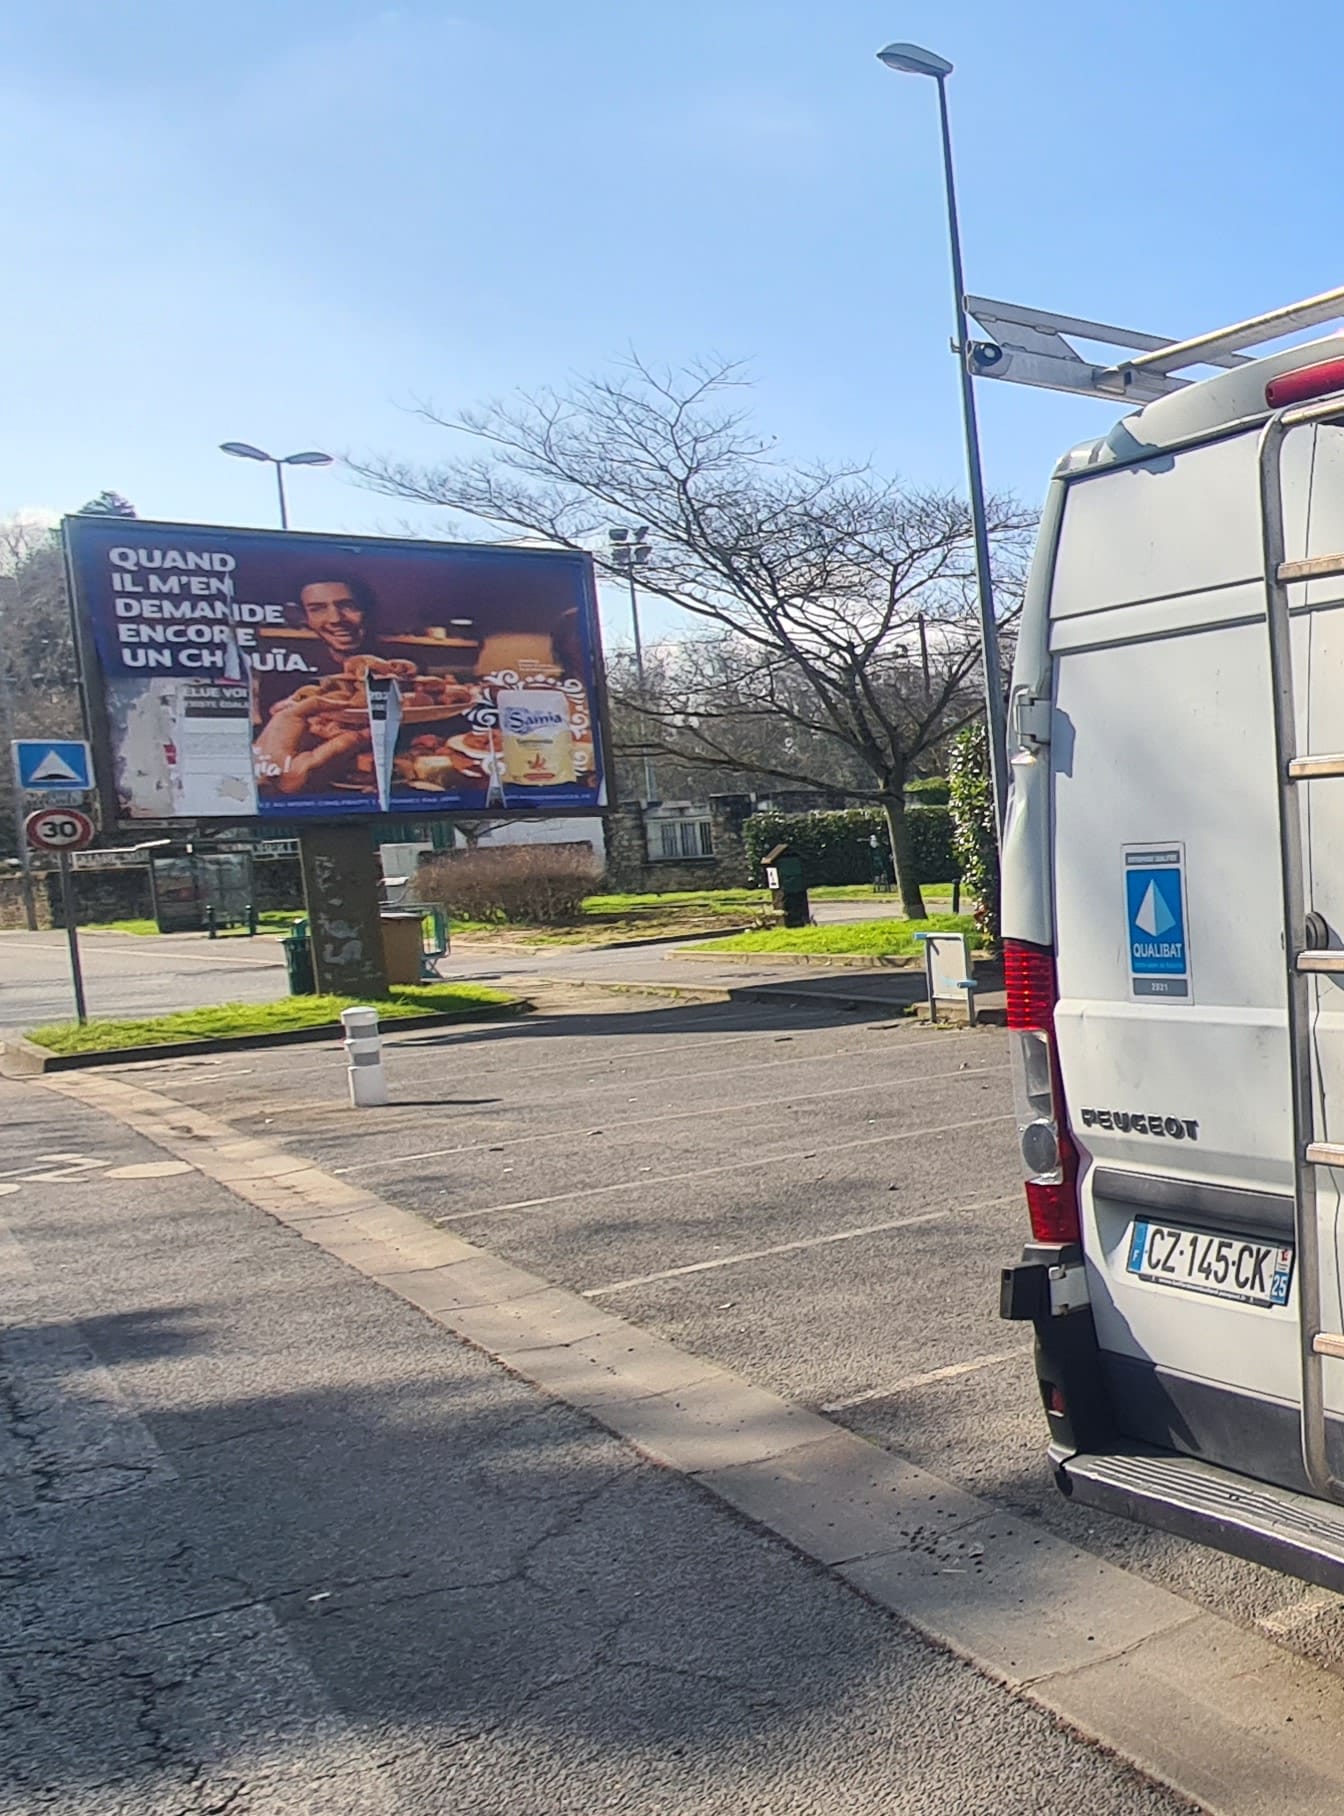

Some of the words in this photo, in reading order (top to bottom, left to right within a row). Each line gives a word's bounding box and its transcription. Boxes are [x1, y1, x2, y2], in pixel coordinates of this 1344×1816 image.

[109, 547, 236, 571] QUAND
[111, 572, 143, 592] IL
[115, 598, 285, 623] DEMANDE
[118, 623, 257, 646] ENCORE
[122, 648, 172, 667] UN
[178, 648, 318, 672] CHUÏA.
[42, 821, 77, 838] 30
[1133, 943, 1182, 958] QUALIBAT
[1080, 1107, 1200, 1141] PEUGEOT
[1132, 1250, 1140, 1262] F
[1272, 1274, 1287, 1296] 25
